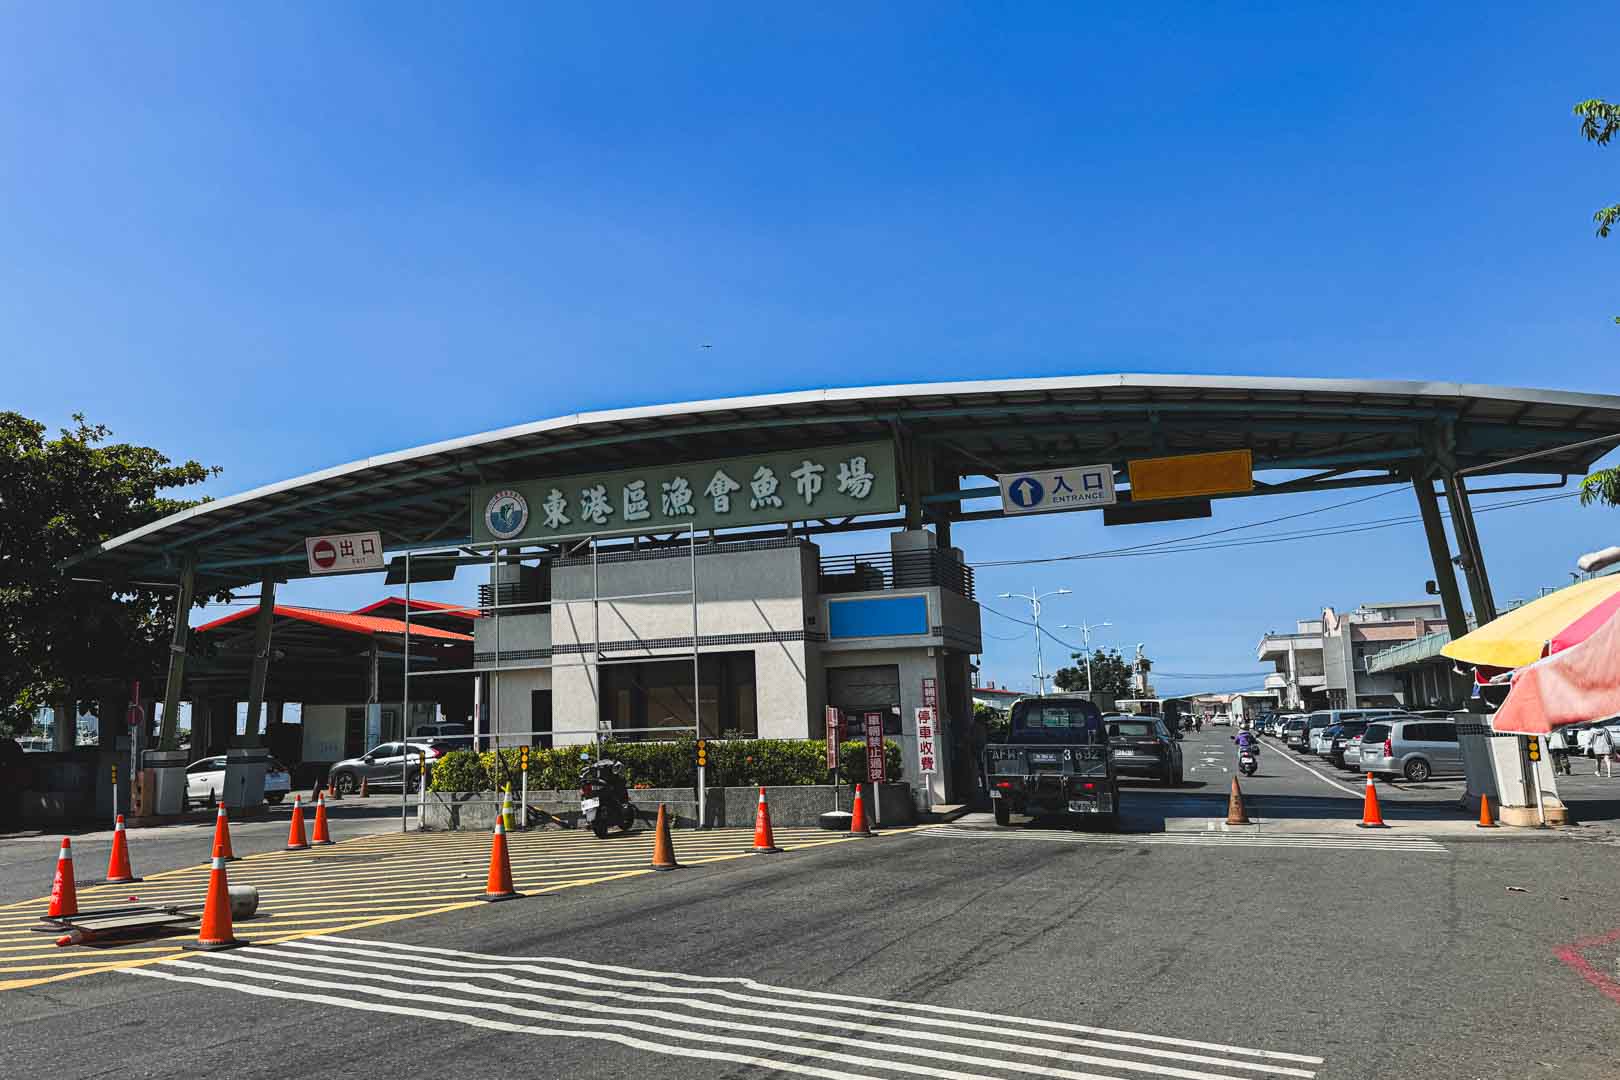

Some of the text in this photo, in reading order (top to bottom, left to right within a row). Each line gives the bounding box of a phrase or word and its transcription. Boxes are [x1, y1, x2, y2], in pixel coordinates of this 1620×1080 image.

[543, 456, 875, 529] 東港區漁會魚市場
[1052, 472, 1103, 494] 入口
[1053, 492, 1104, 504] ENTRANCE
[340, 538, 375, 557] 出口
[918, 710, 934, 771] 停車收費
